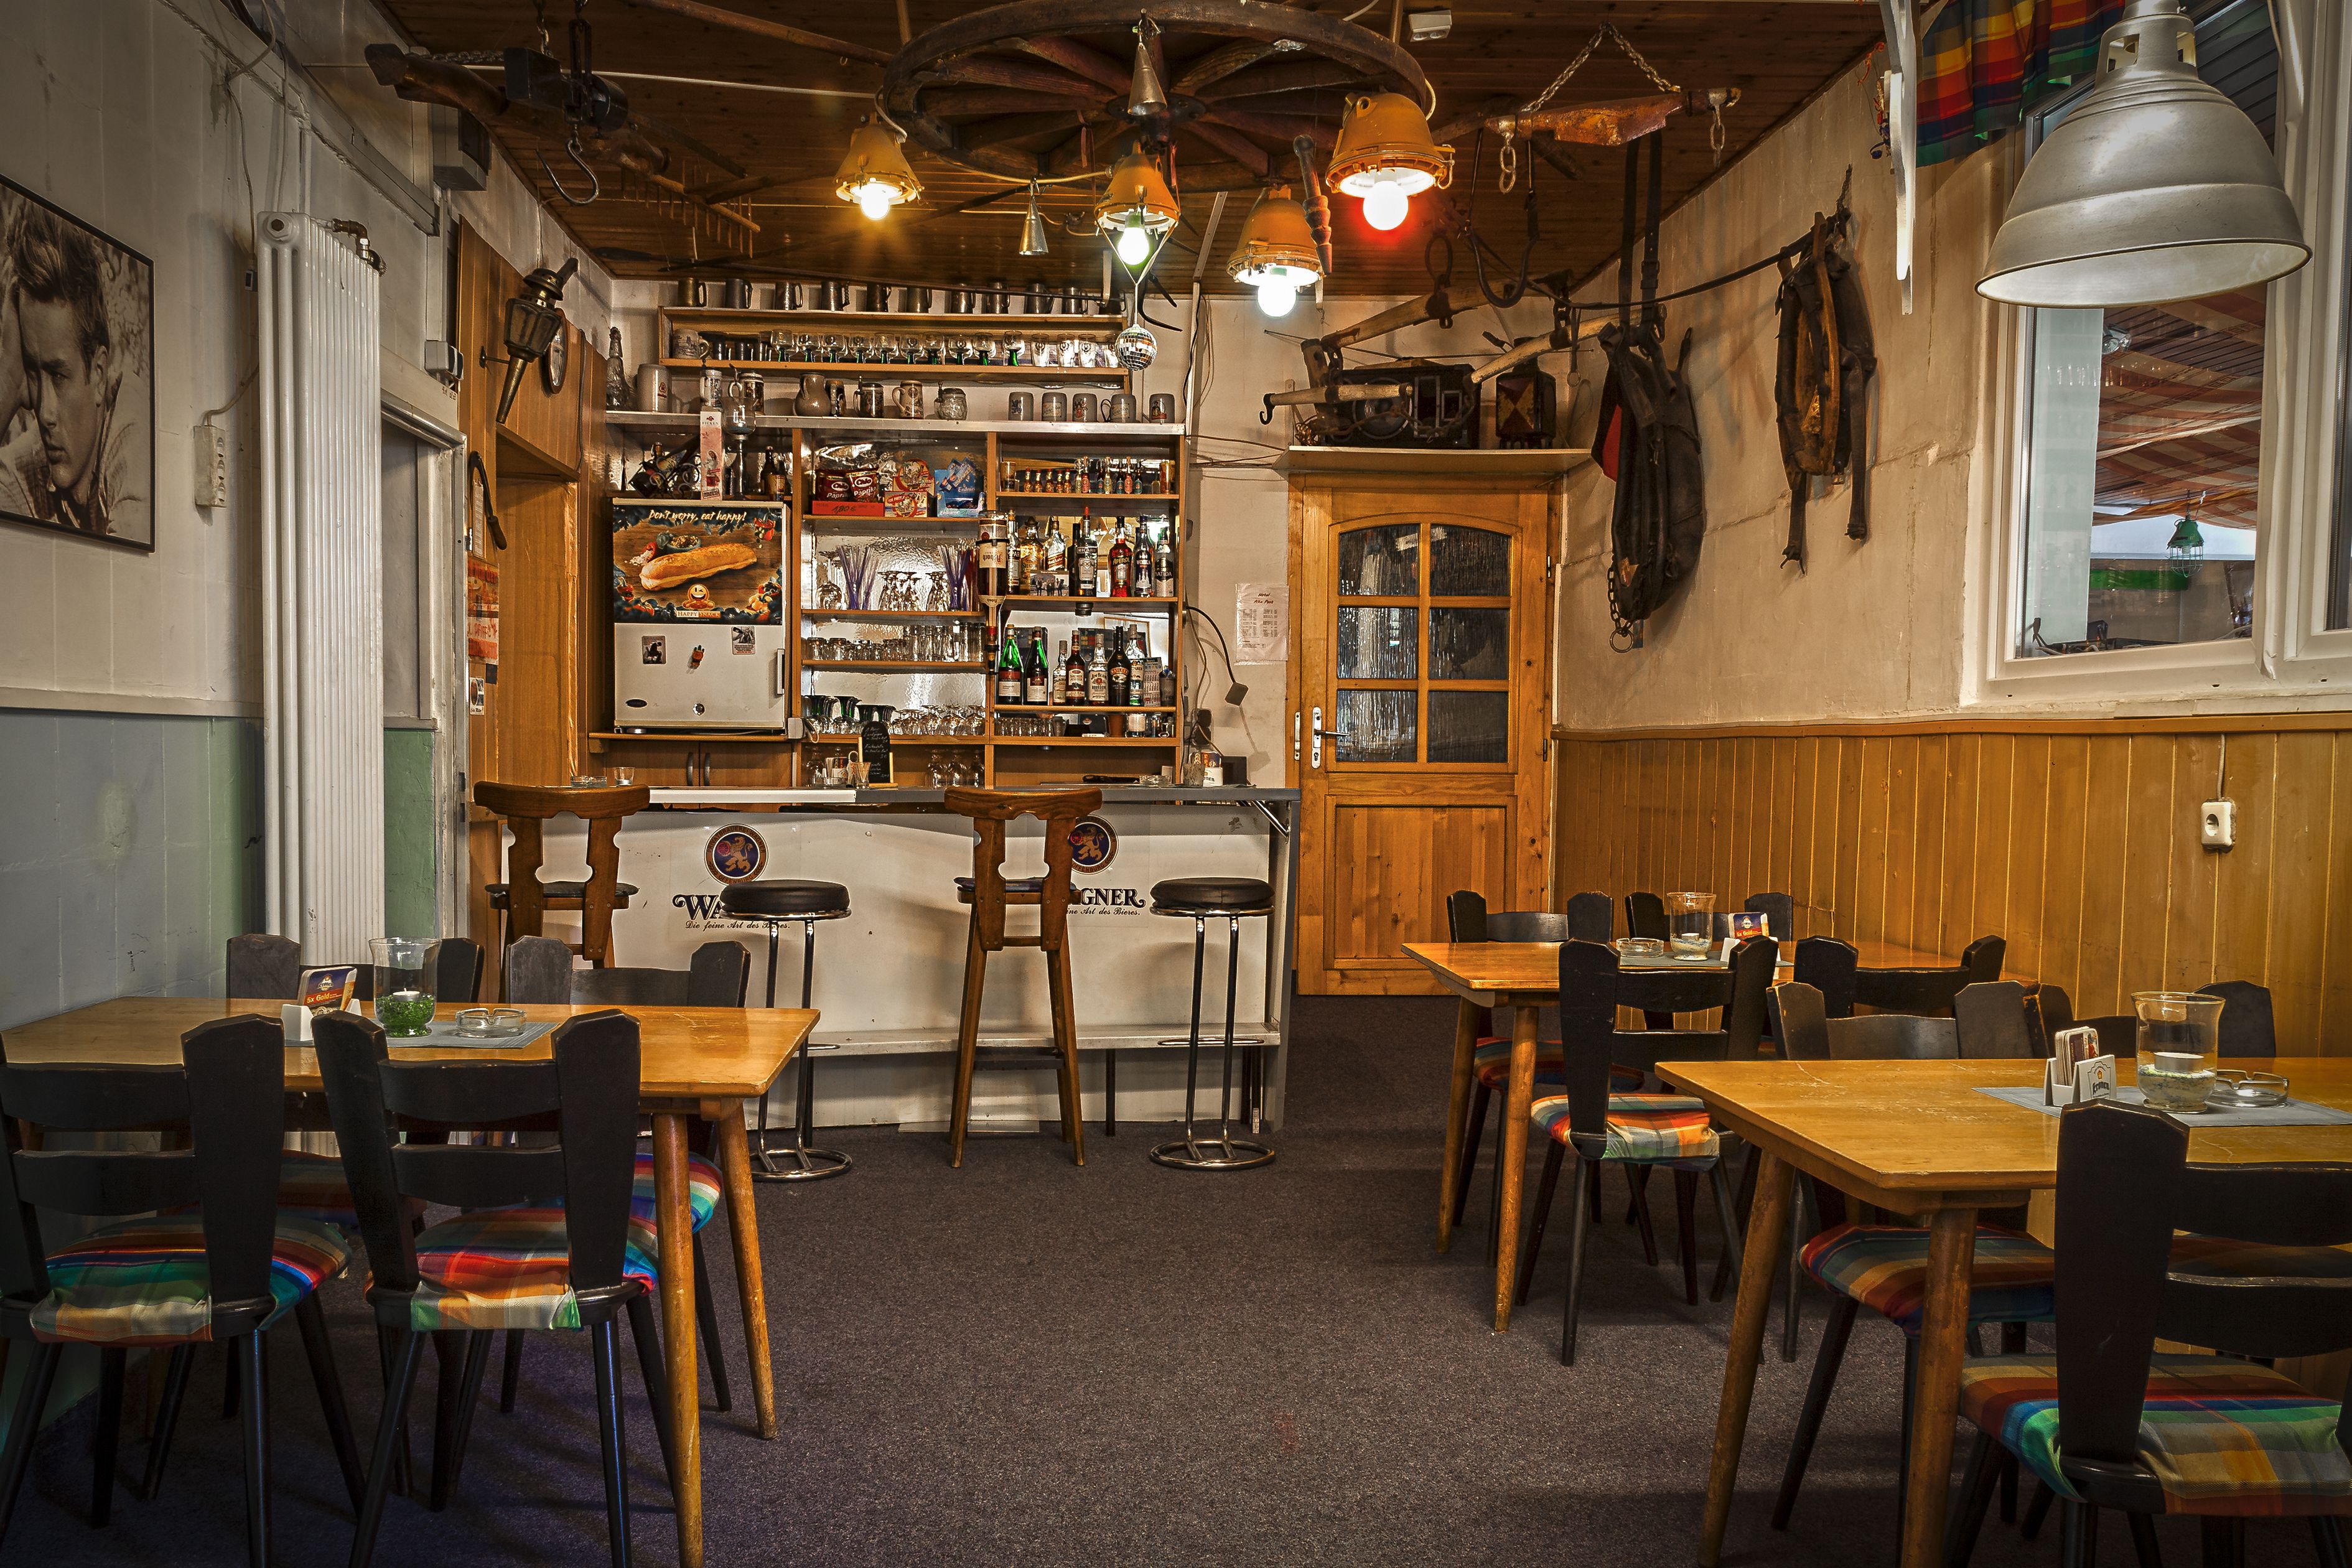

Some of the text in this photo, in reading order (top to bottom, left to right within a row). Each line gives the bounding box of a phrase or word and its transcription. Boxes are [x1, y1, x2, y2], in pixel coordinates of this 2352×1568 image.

[856, 478, 872, 486] Chio
[648, 510, 747, 524] Don't worry, eat happy!
[1075, 887, 1146, 908] GNER
[1080, 907, 1096, 915] Art
[1098, 907, 1111, 915] des
[1113, 907, 1141, 916] Bieres.
[685, 920, 701, 929] Die
[702, 920, 725, 931] feine
[727, 921, 744, 929] Art
[746, 921, 760, 929] des
[316, 992, 330, 1001] Gold
